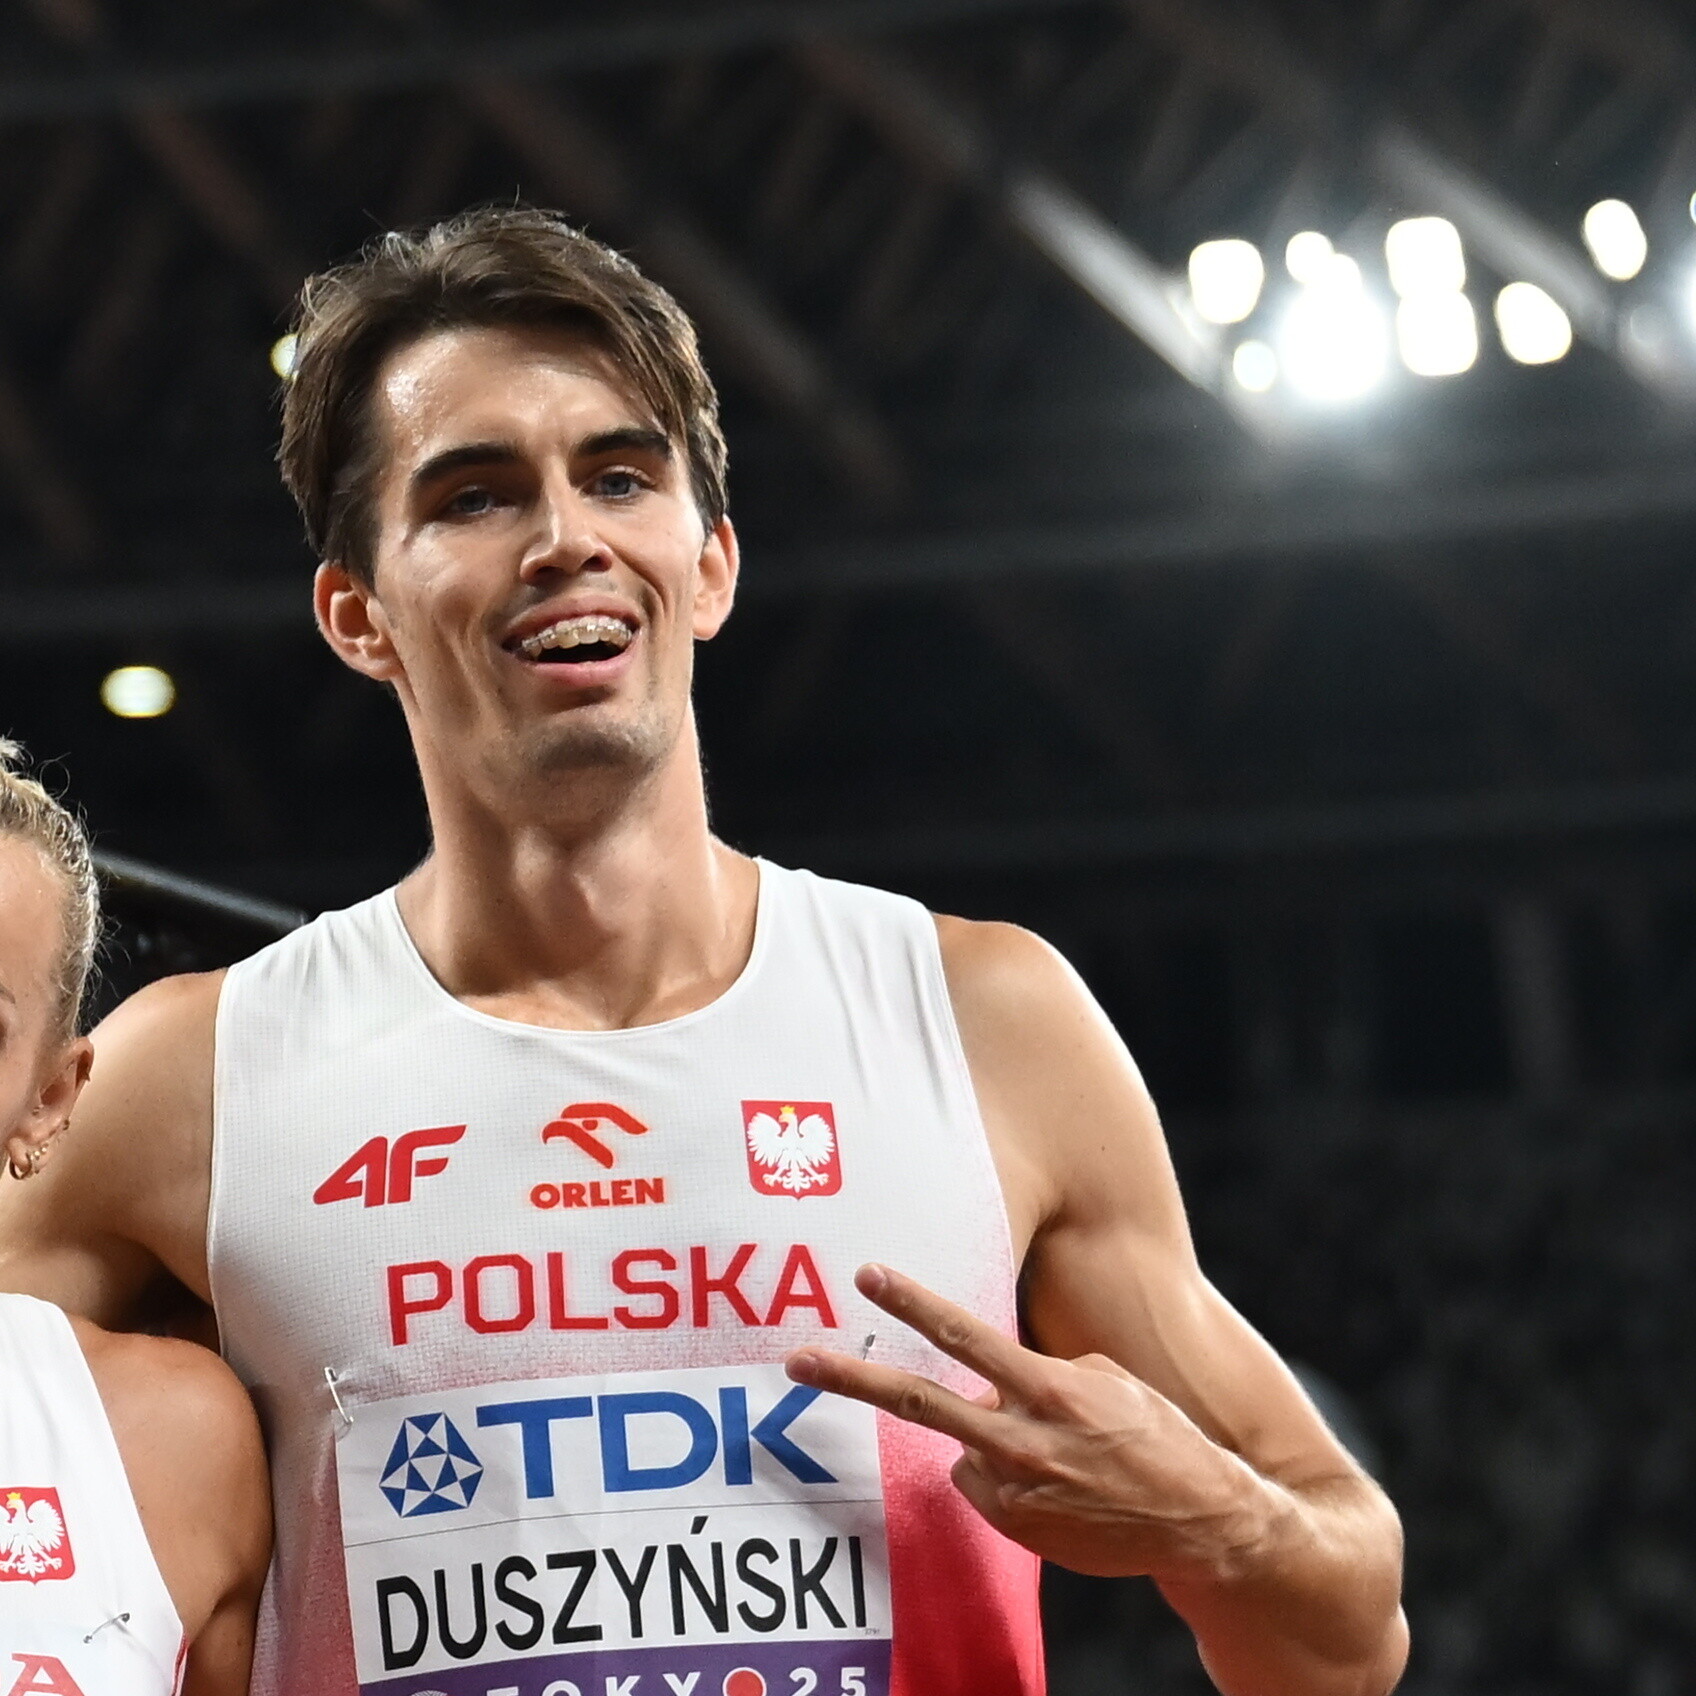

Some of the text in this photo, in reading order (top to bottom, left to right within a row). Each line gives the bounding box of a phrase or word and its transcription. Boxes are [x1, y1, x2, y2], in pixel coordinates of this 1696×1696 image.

[313, 1125, 467, 1208] 4F
[530, 1177, 664, 1209] ORLEN
[387, 1243, 837, 1346] POLSKA
[477, 1386, 839, 1499] TDK
[376, 1516, 867, 1671] DUSZYŃSKI
